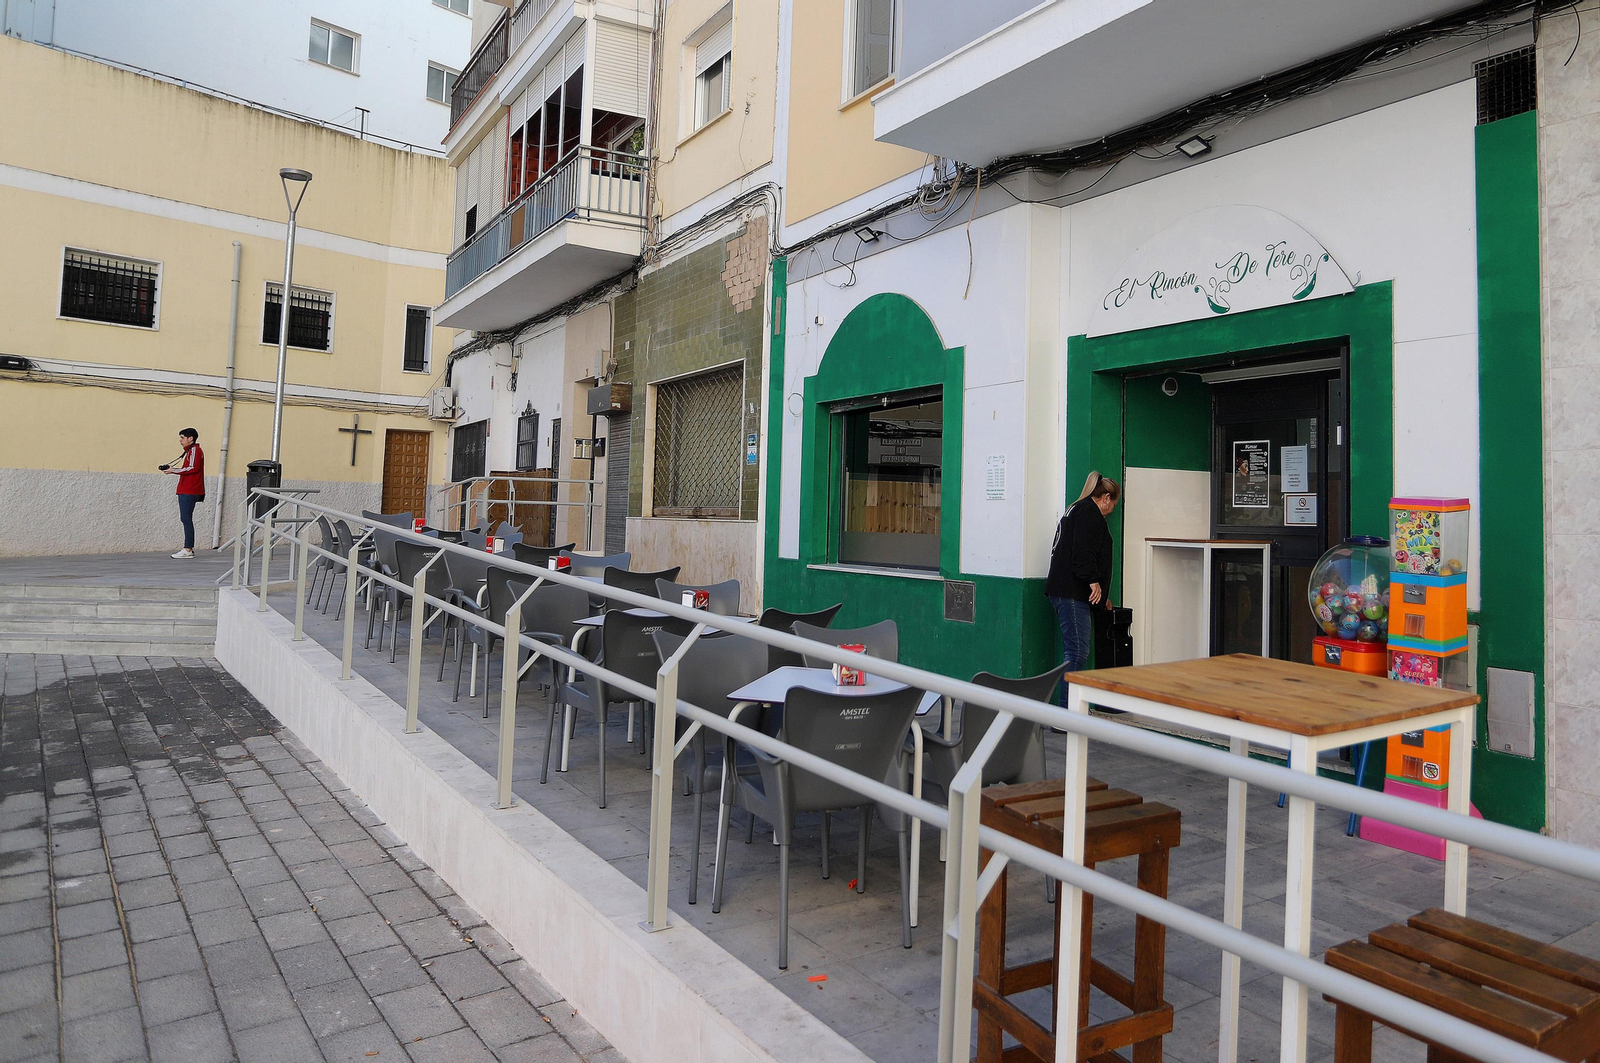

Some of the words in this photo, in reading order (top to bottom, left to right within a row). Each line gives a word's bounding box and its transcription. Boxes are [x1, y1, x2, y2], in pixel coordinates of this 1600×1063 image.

[1104, 278, 1137, 310] El
[1137, 270, 1198, 300] Rincón
[1215, 251, 1259, 284] De
[1265, 240, 1297, 277] Tere
[1405, 536, 1433, 549] MIX
[1404, 670, 1425, 679] SUPER
[839, 707, 870, 716] AMSTEL
